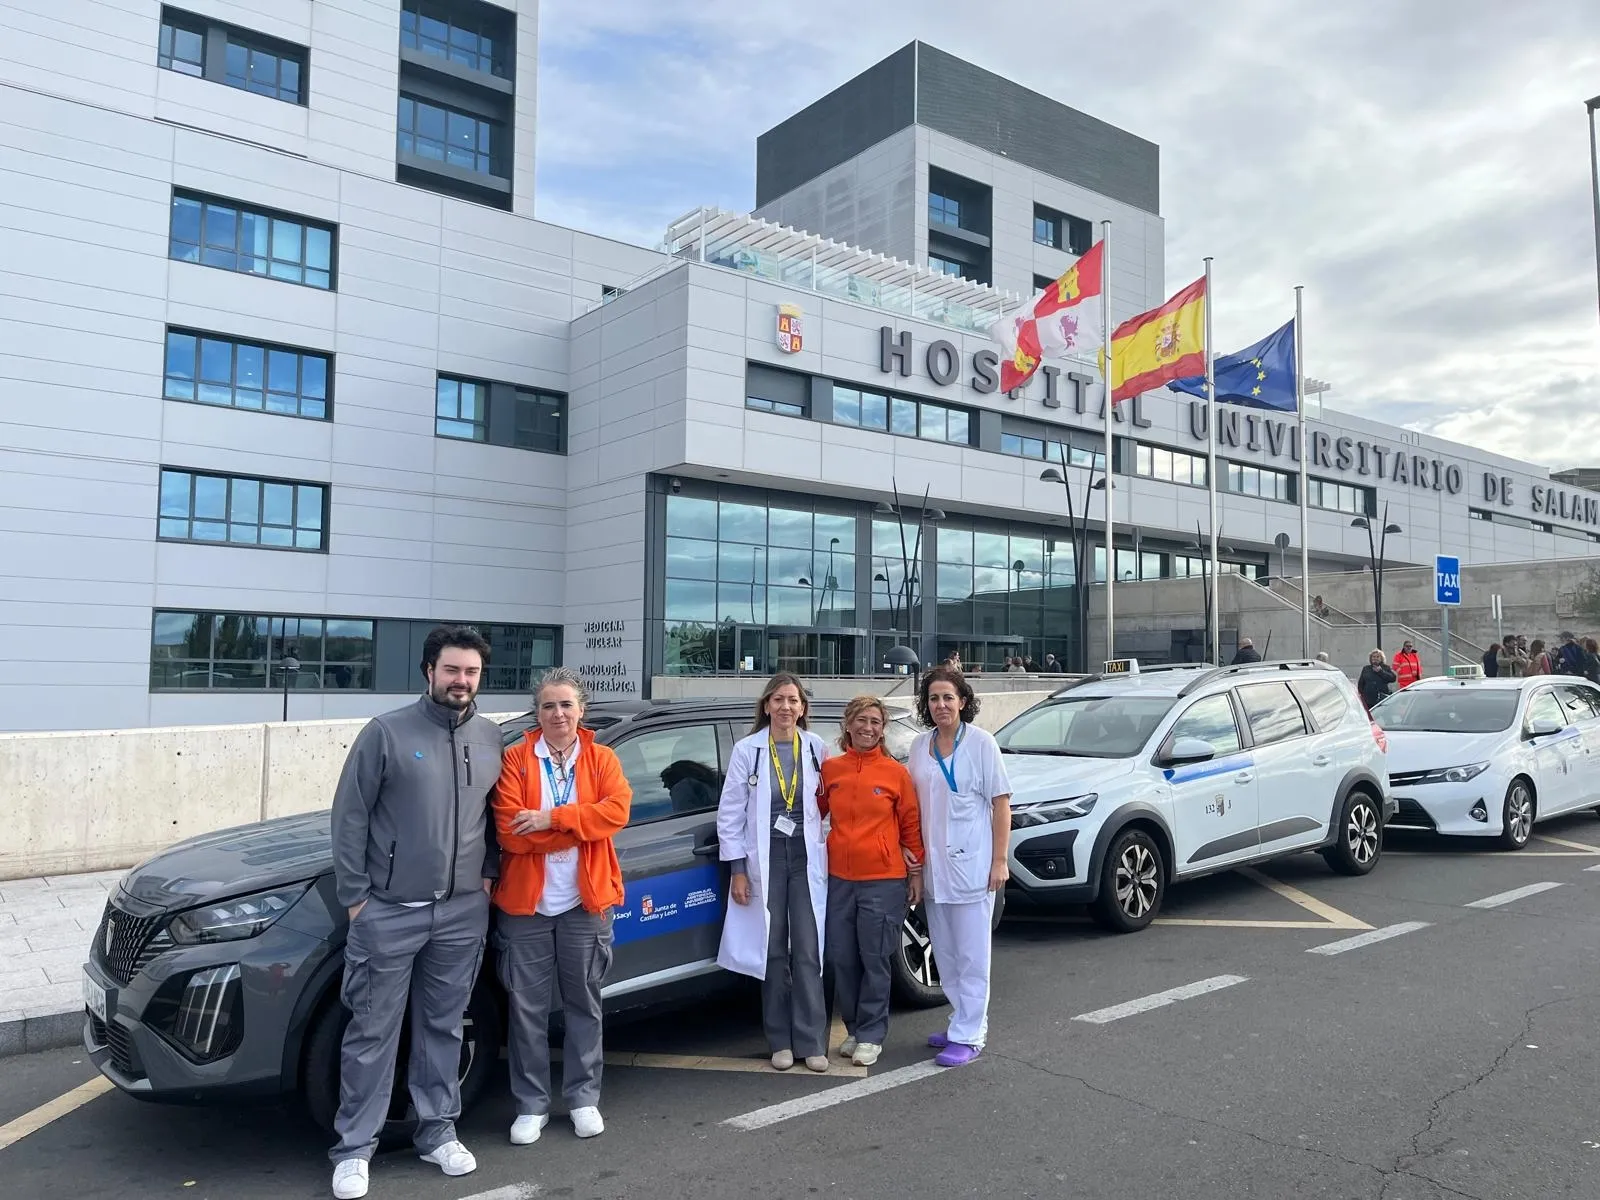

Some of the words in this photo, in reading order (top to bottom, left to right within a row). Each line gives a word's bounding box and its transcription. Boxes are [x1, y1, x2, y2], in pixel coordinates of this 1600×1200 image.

[1484, 473, 1513, 506] DE
[1531, 485, 1599, 525] SALAM
[1438, 573, 1459, 587] TAXI
[584, 620, 624, 632] MEDICINA
[585, 637, 622, 648] NUCLEAR
[580, 661, 626, 676] ONCOLOGÍA
[1108, 662, 1124, 672] TAXI
[617, 910, 632, 920] Sacyl
[640, 913, 659, 922] Castilla
[664, 909, 678, 917] León
